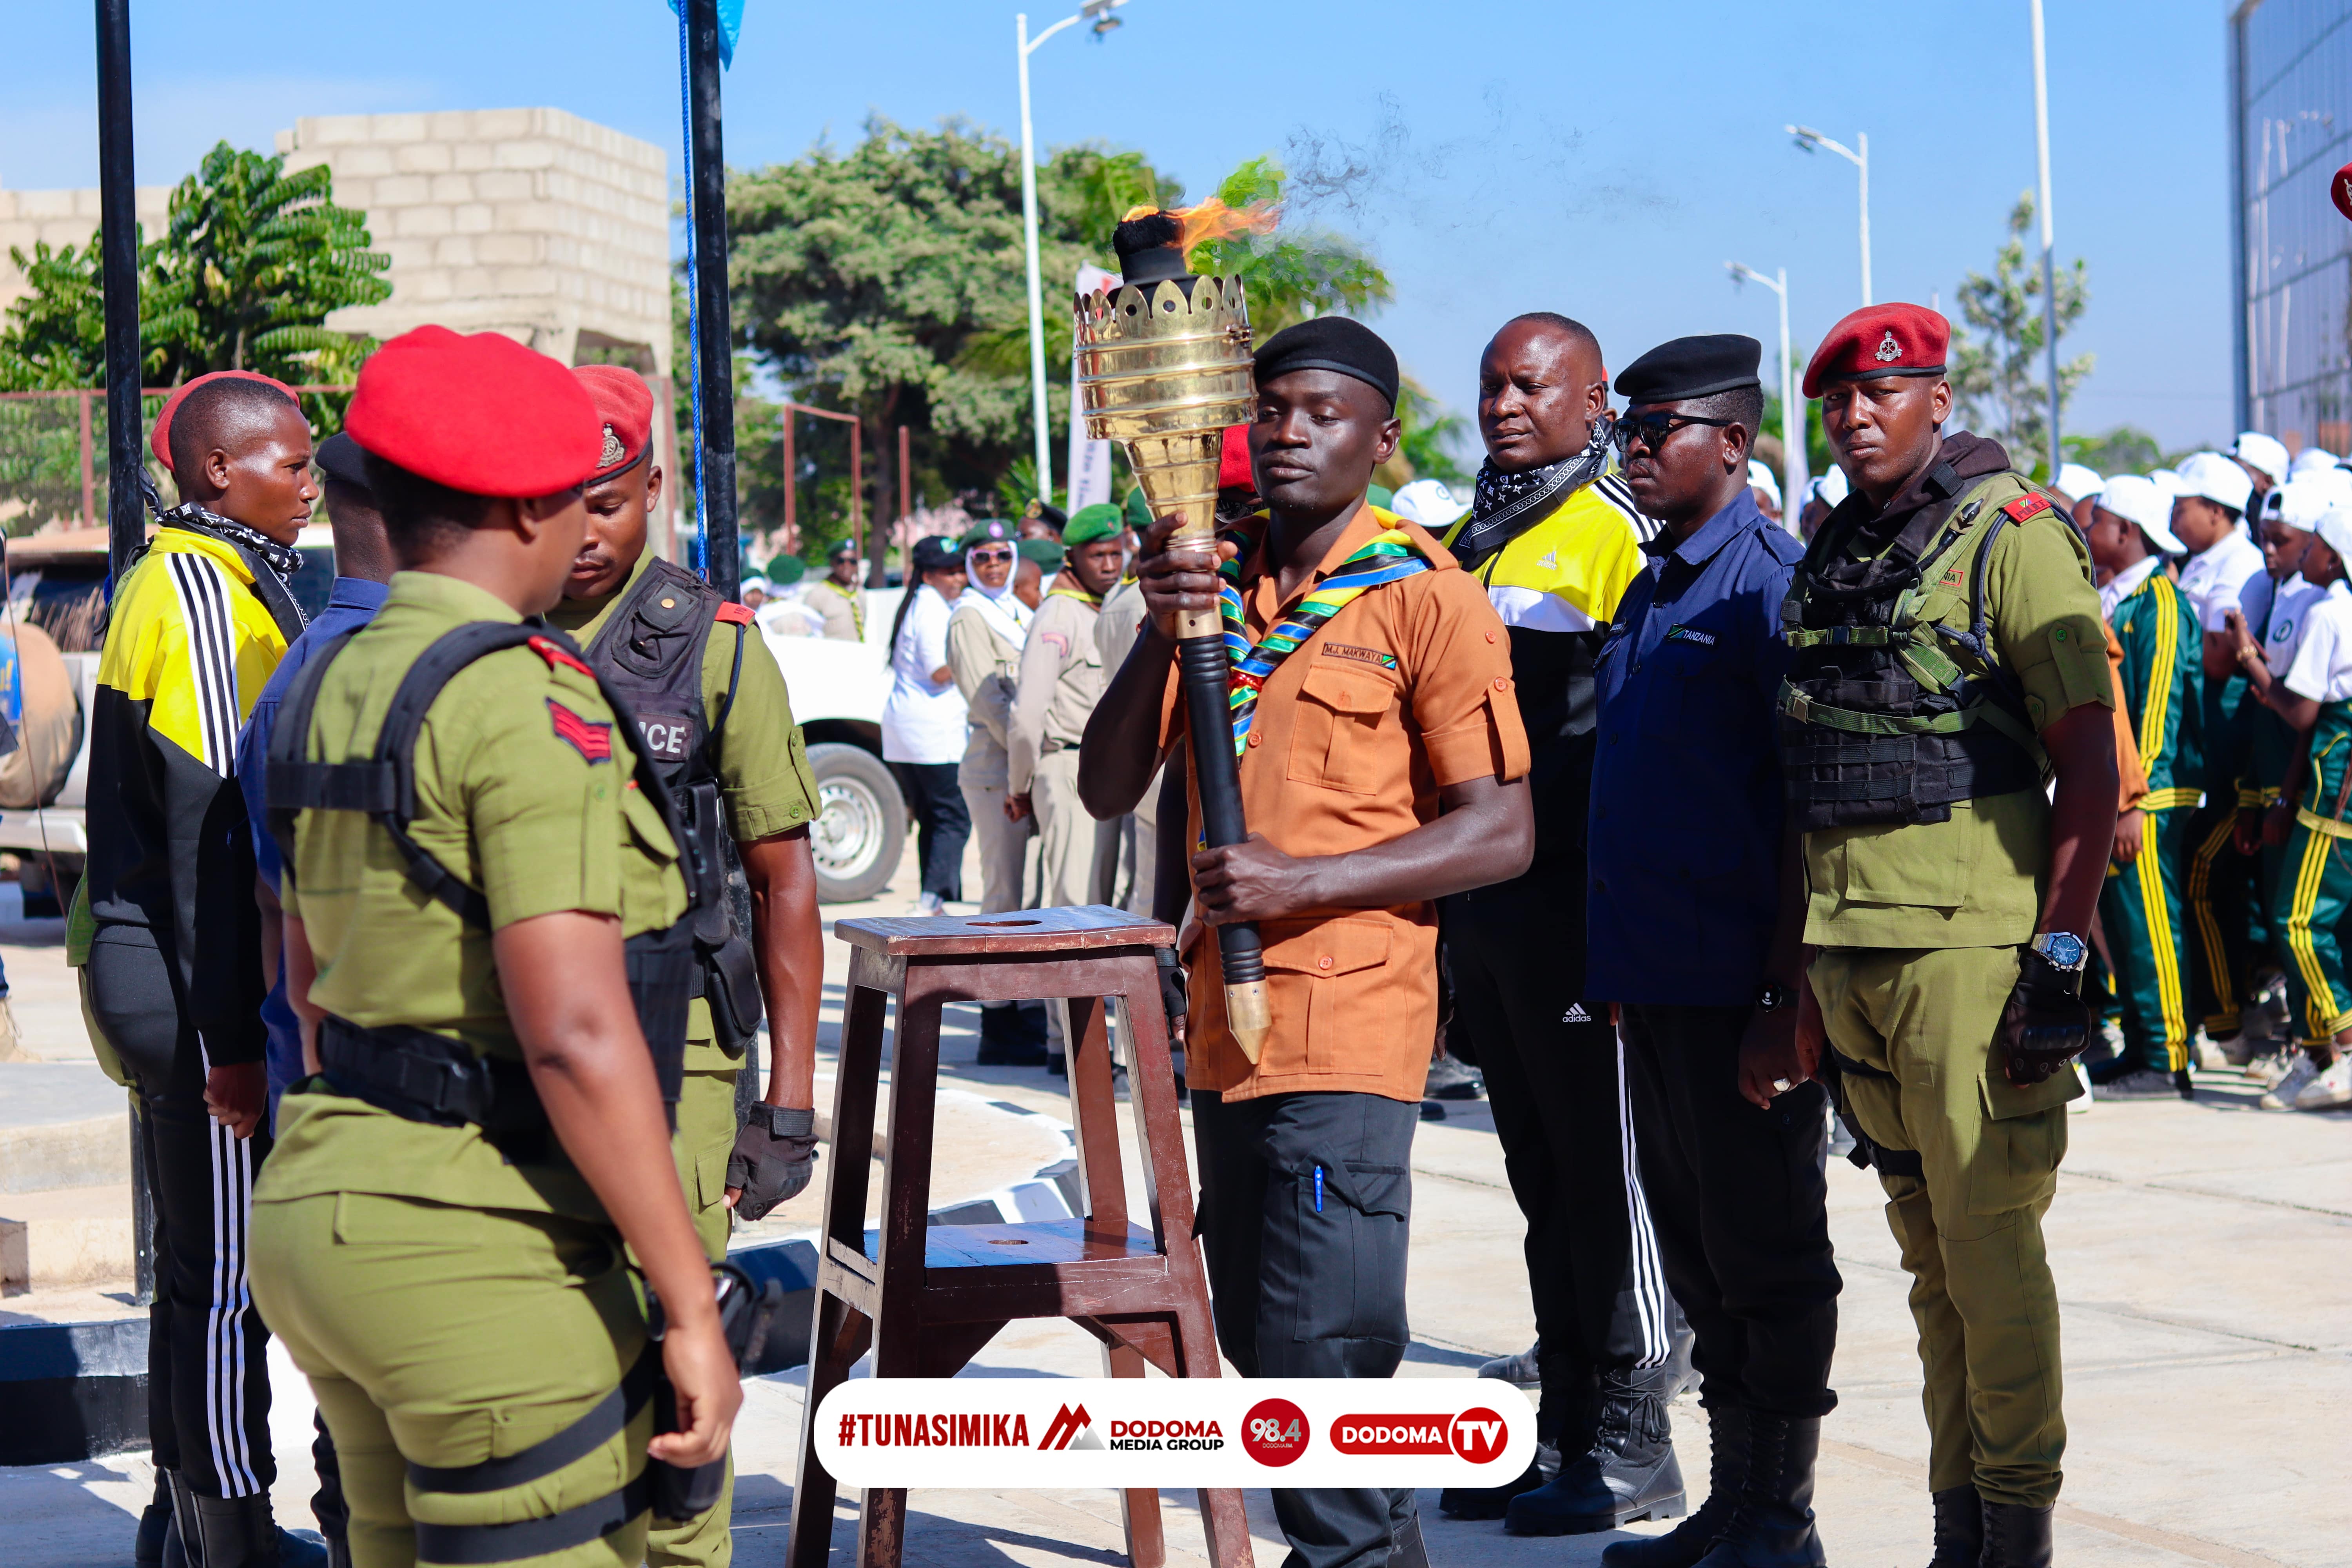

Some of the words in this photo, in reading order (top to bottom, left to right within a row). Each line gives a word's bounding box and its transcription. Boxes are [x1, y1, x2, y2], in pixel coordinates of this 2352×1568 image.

[1537, 560, 1557, 570] adidas
[1683, 630, 1715, 646] TANZANIA
[1342, 648, 1381, 662] MAKWAYA
[1563, 1014, 1592, 1022] adidas
